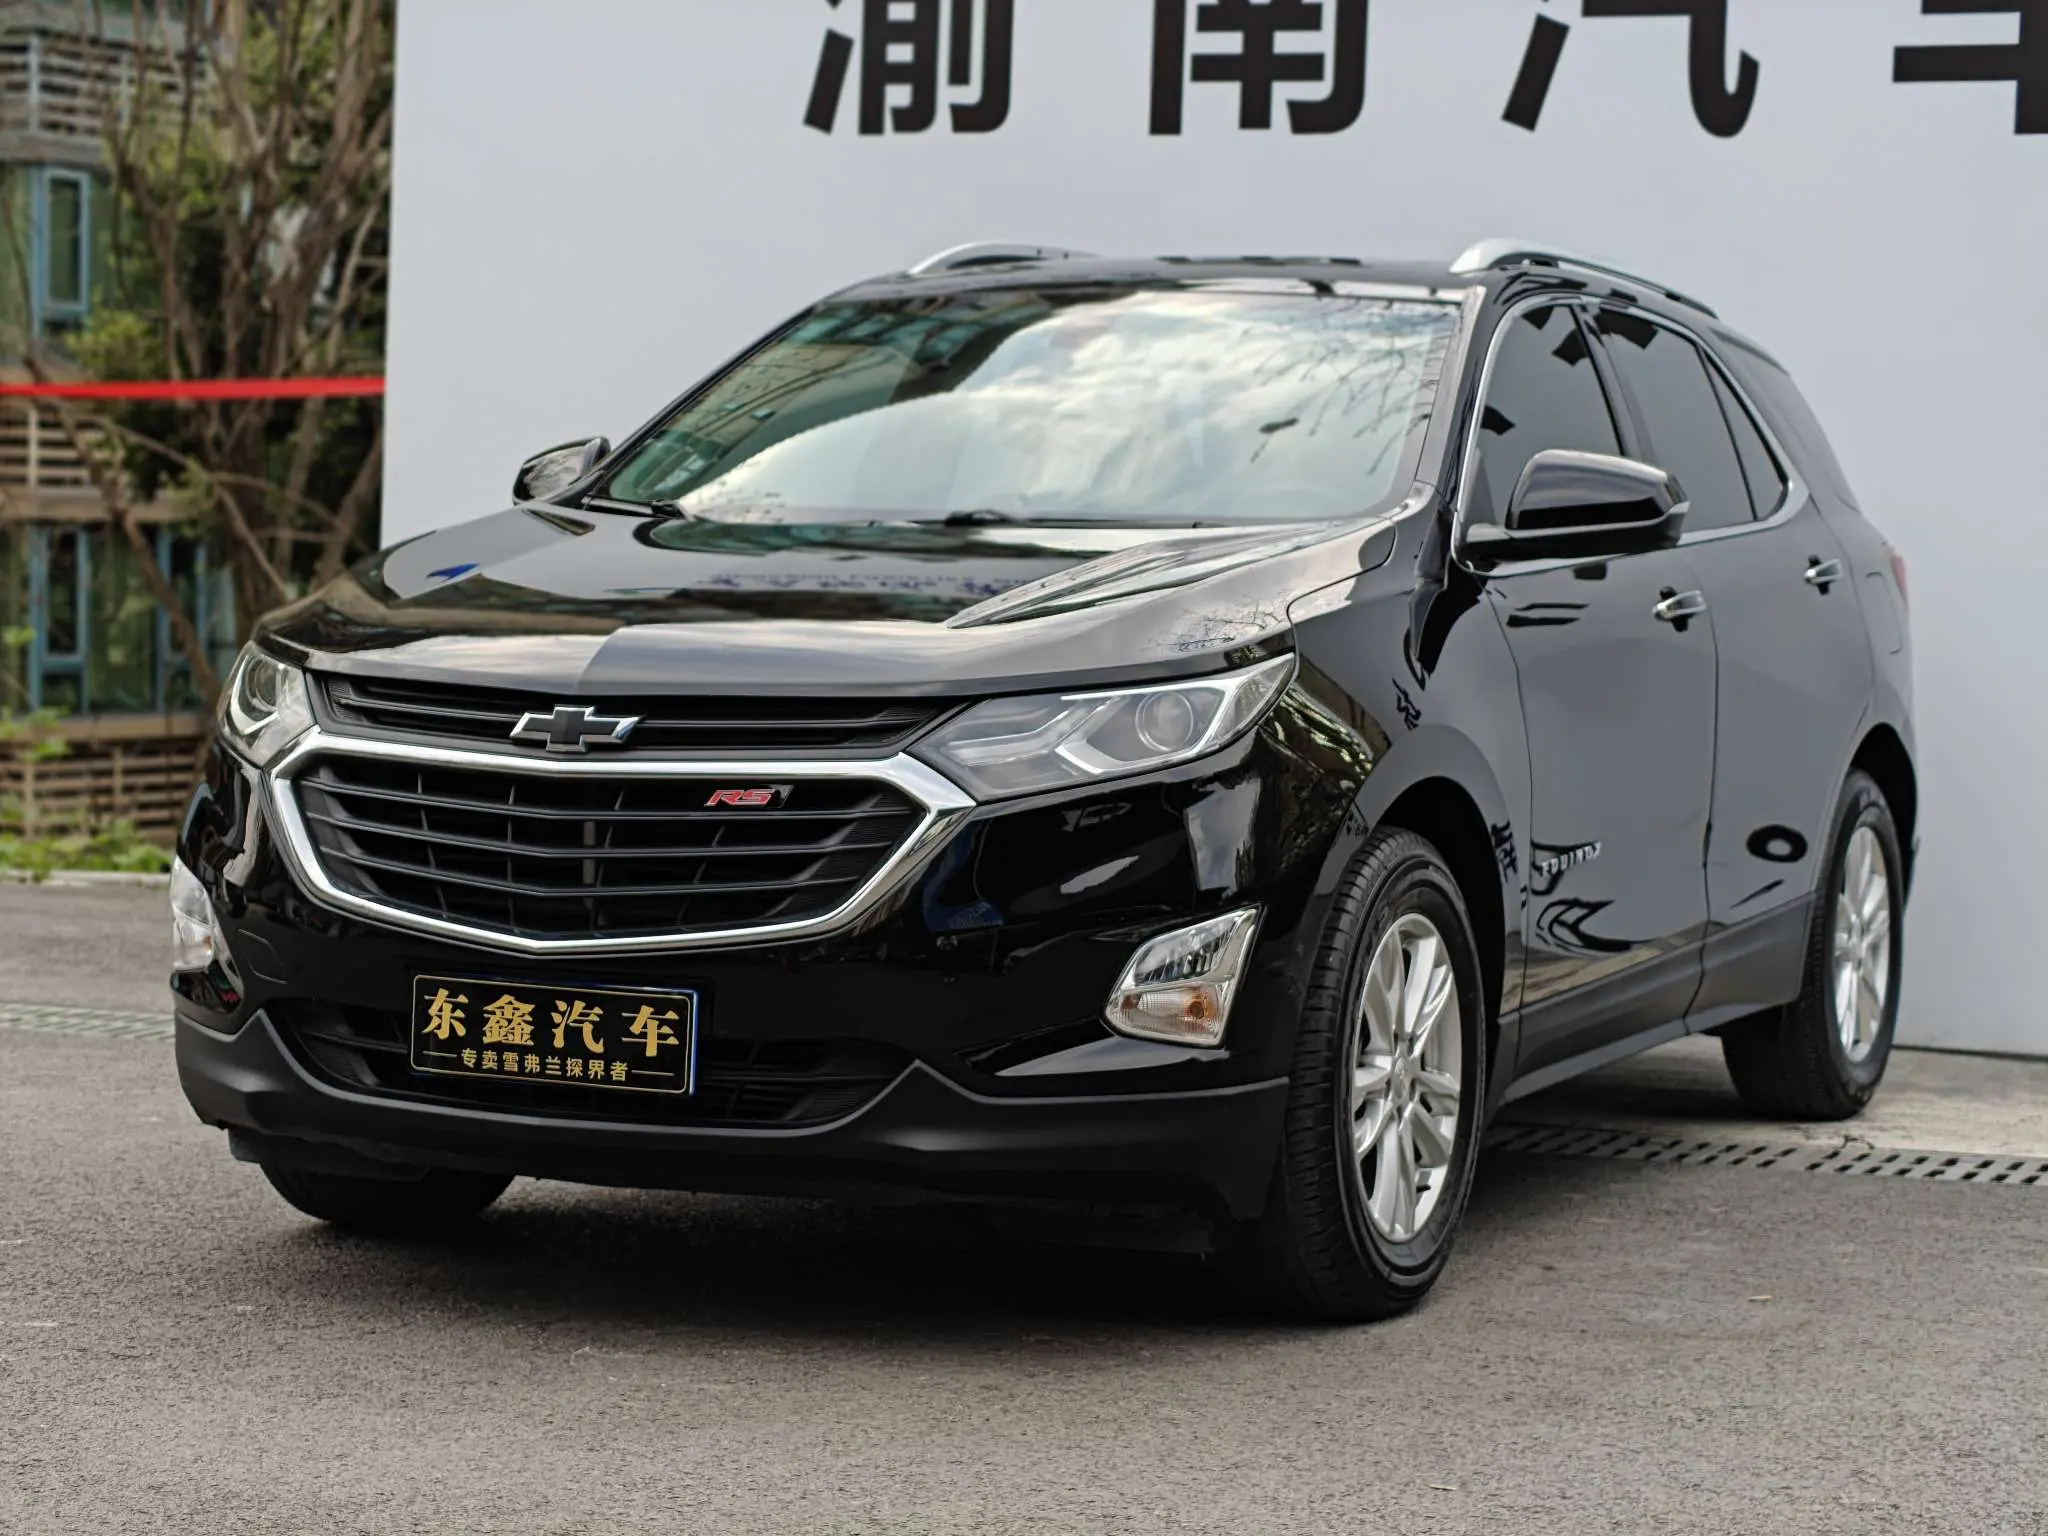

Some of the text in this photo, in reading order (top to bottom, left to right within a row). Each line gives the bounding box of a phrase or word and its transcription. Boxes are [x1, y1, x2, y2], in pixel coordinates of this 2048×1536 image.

[704, 788, 776, 807] RS
[421, 987, 680, 1057] 东鑫汽车
[461, 1047, 628, 1082] 专卖雪弗兰探界者
